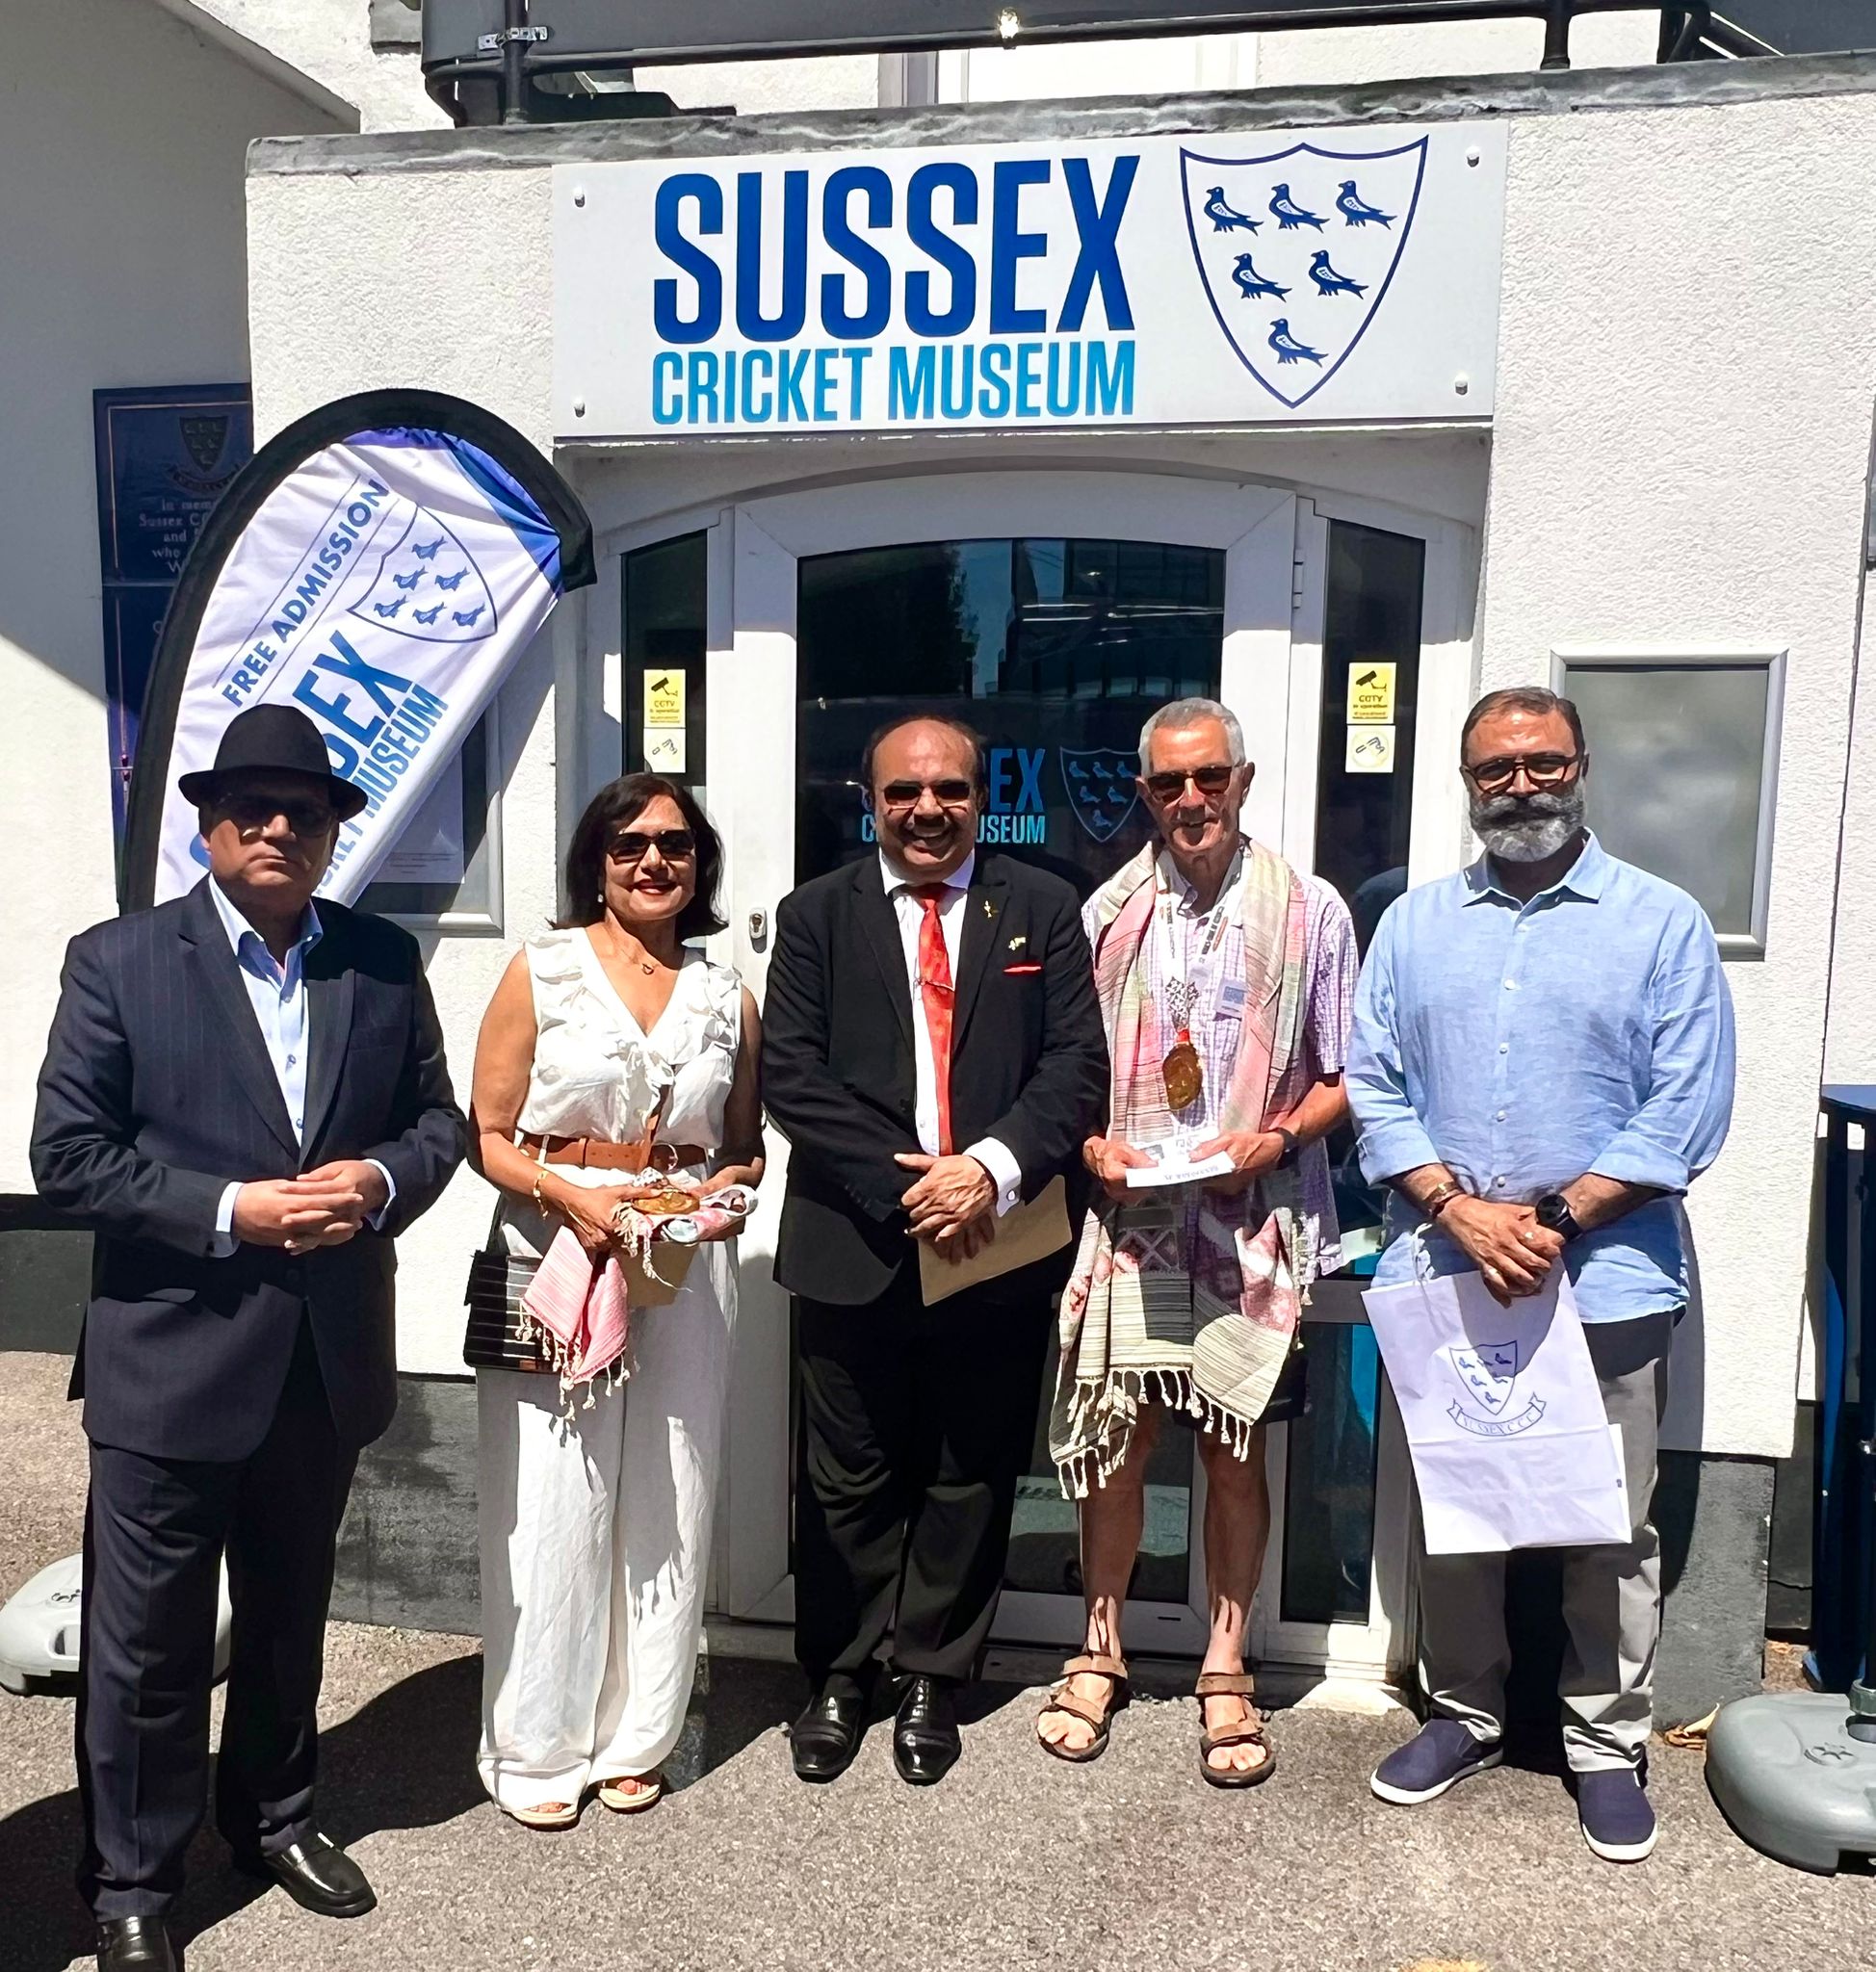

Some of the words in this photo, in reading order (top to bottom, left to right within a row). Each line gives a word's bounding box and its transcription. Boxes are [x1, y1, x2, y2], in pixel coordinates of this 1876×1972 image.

[653, 154, 1141, 345] SUSSEX
[652, 348, 873, 427] CRICKET
[887, 340, 1136, 423] MUSEUM
[139, 513, 183, 527] Sussex
[164, 530, 187, 542] and
[151, 546, 181, 558] who
[221, 640, 277, 708] FREE
[272, 479, 390, 643] ADMISSION
[975, 815, 1046, 844] USEUM
